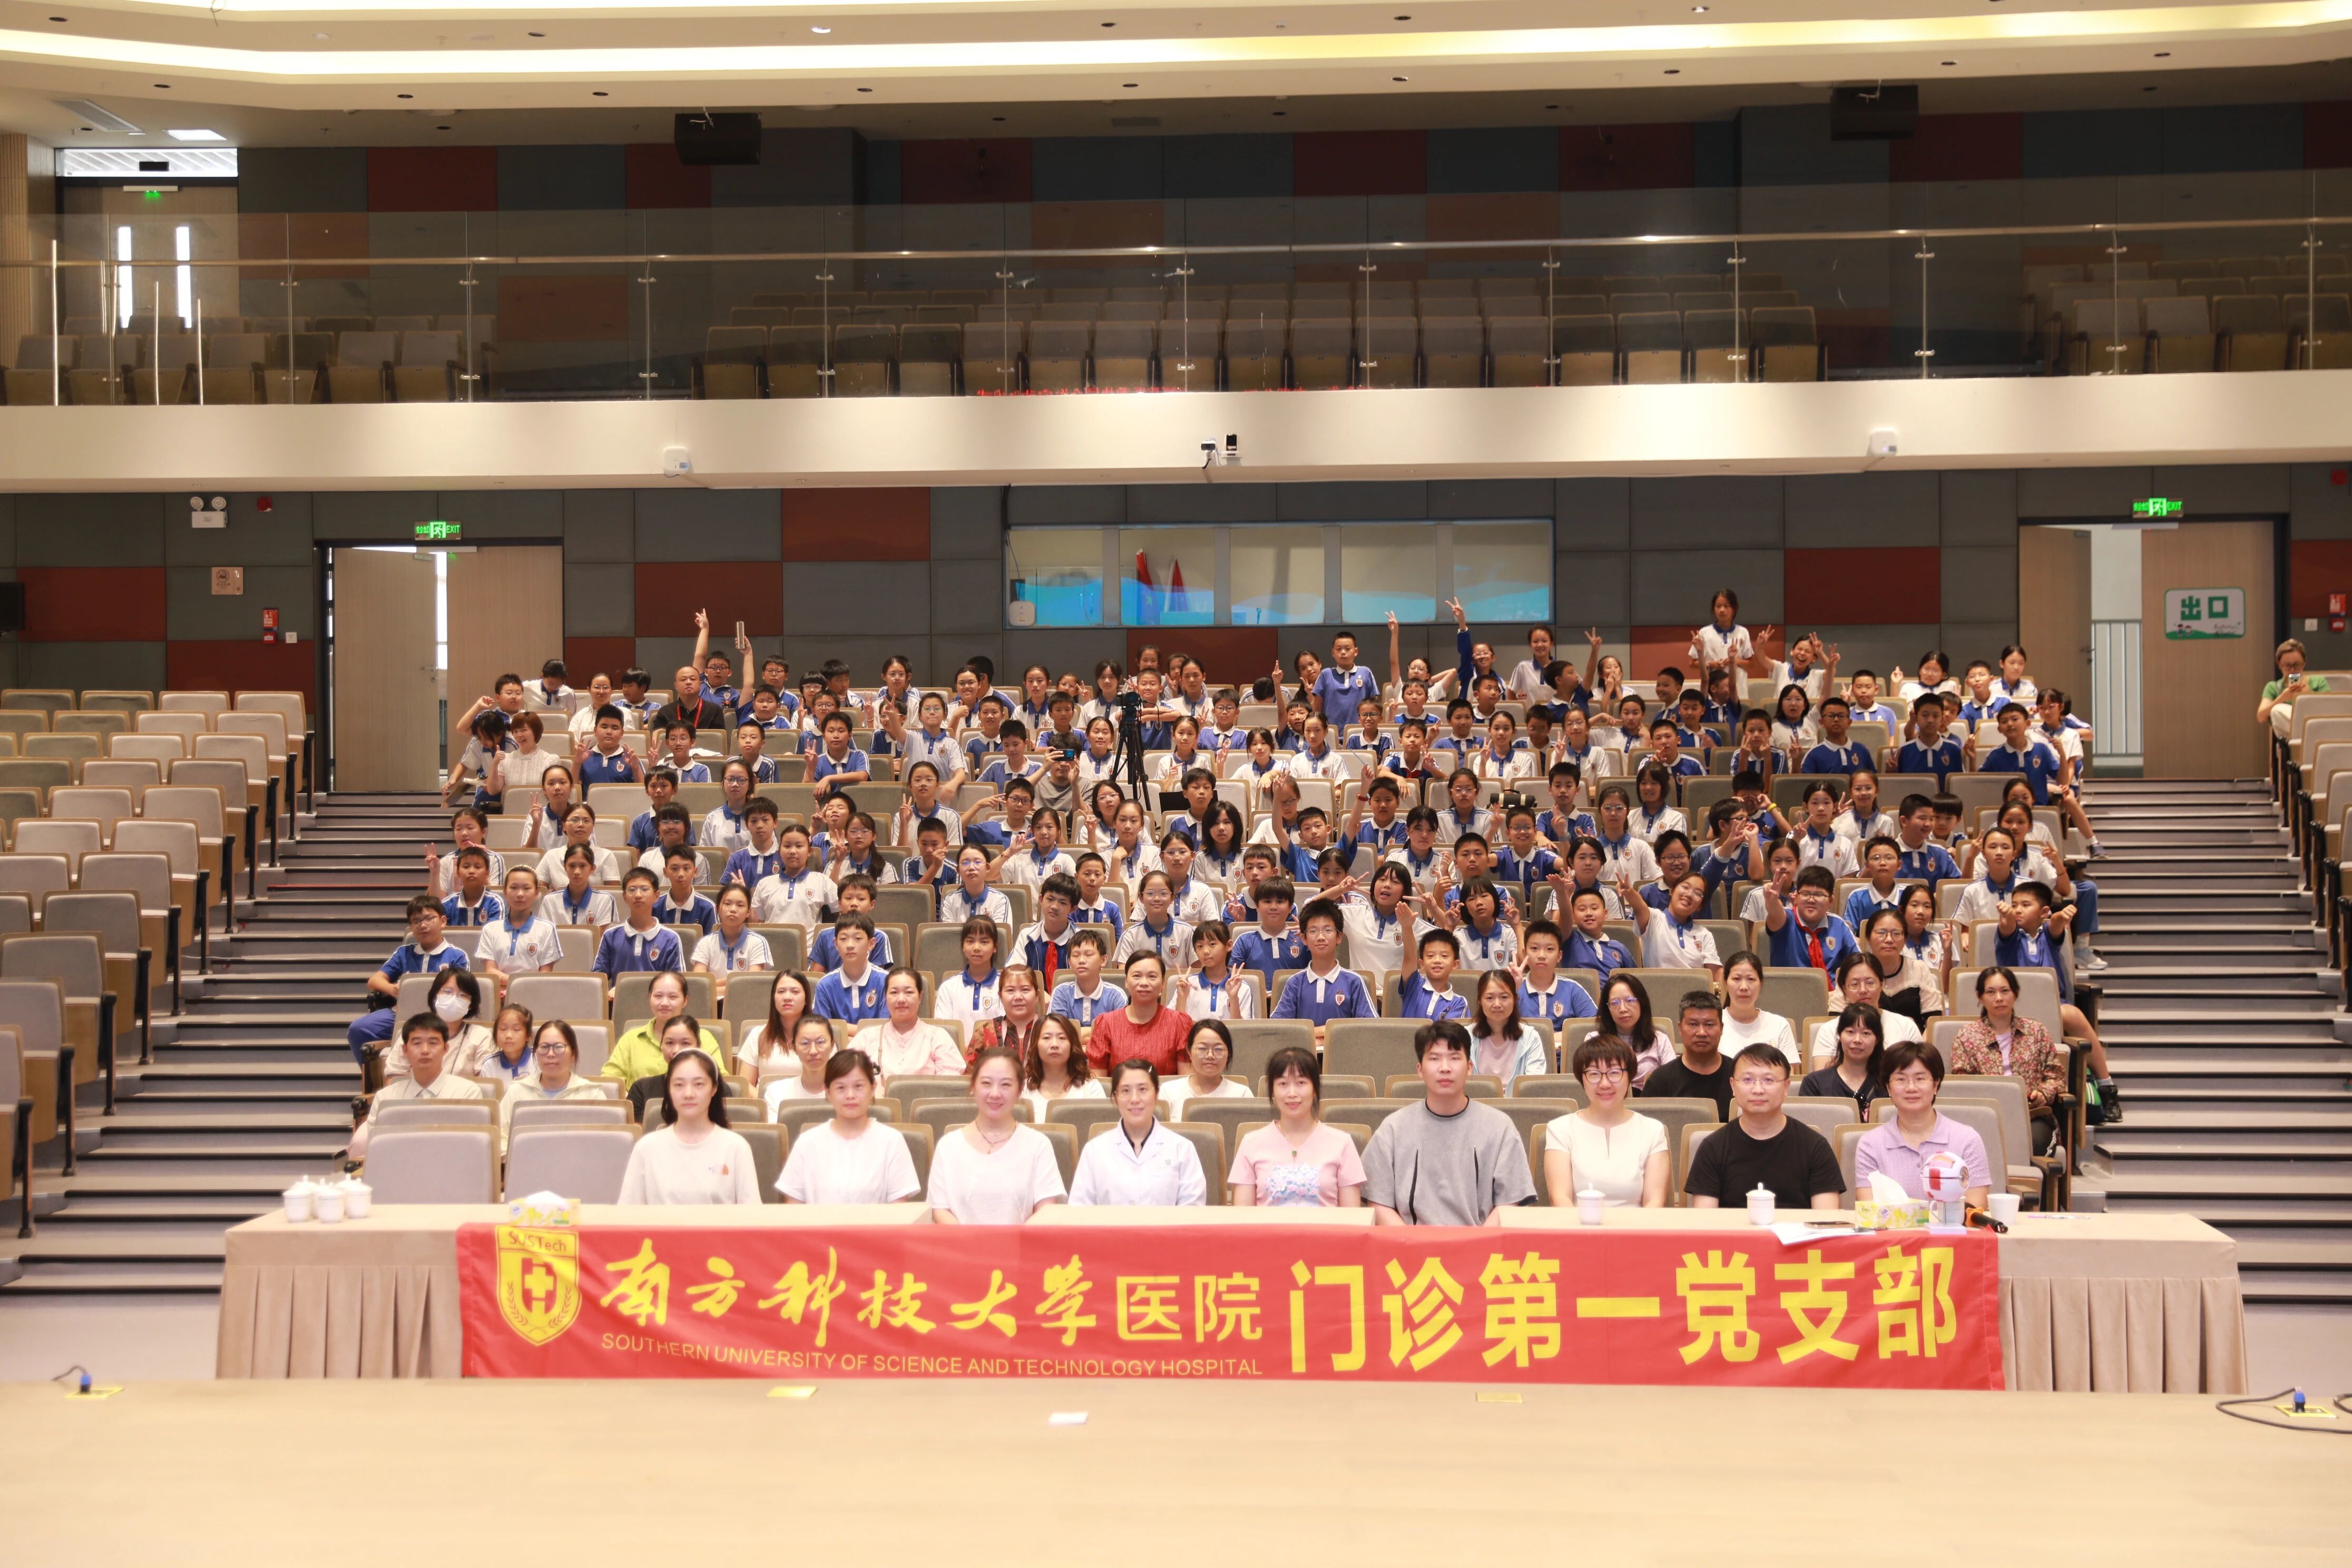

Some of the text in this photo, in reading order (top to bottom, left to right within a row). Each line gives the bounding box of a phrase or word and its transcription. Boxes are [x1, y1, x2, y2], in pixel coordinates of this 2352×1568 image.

[2167, 501, 2182, 511] EXIT
[2181, 595, 2229, 621] 出口
[508, 1230, 566, 1252] SUSTech
[601, 1333, 1262, 1375] SOUTHERN UNIVERSITY OF SCIENCE AND TECHNOLOGY HOSPITAL
